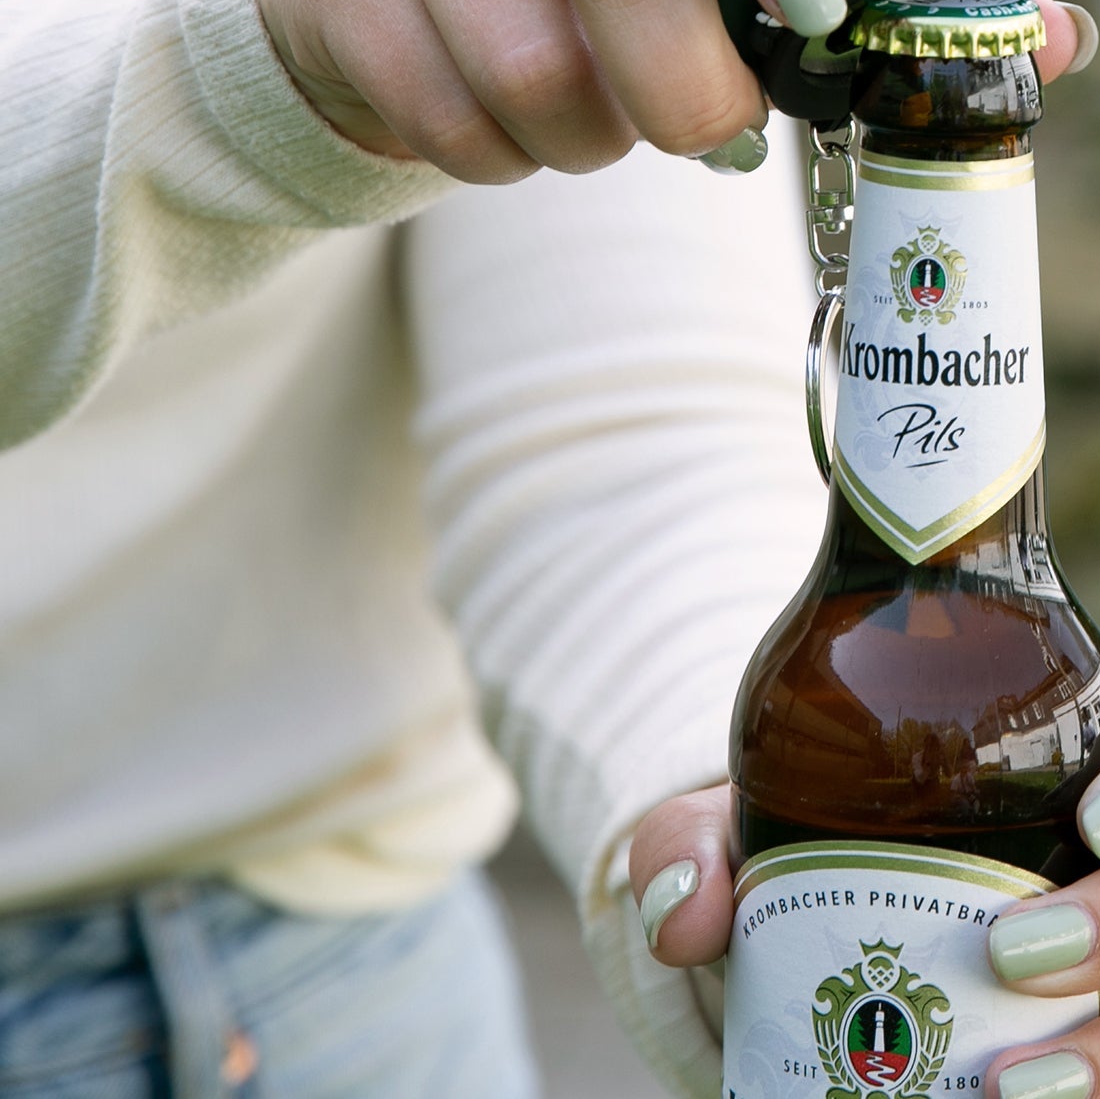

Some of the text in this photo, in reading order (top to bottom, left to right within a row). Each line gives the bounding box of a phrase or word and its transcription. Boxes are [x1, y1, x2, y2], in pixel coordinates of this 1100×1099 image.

[873, 295, 989, 310] SEIT 1803
[841, 322, 1030, 387] Krombacher
[877, 403, 965, 460] Pils
[742, 890, 856, 939] KROMBACHER
[783, 1059, 981, 1090] SEIT 180
